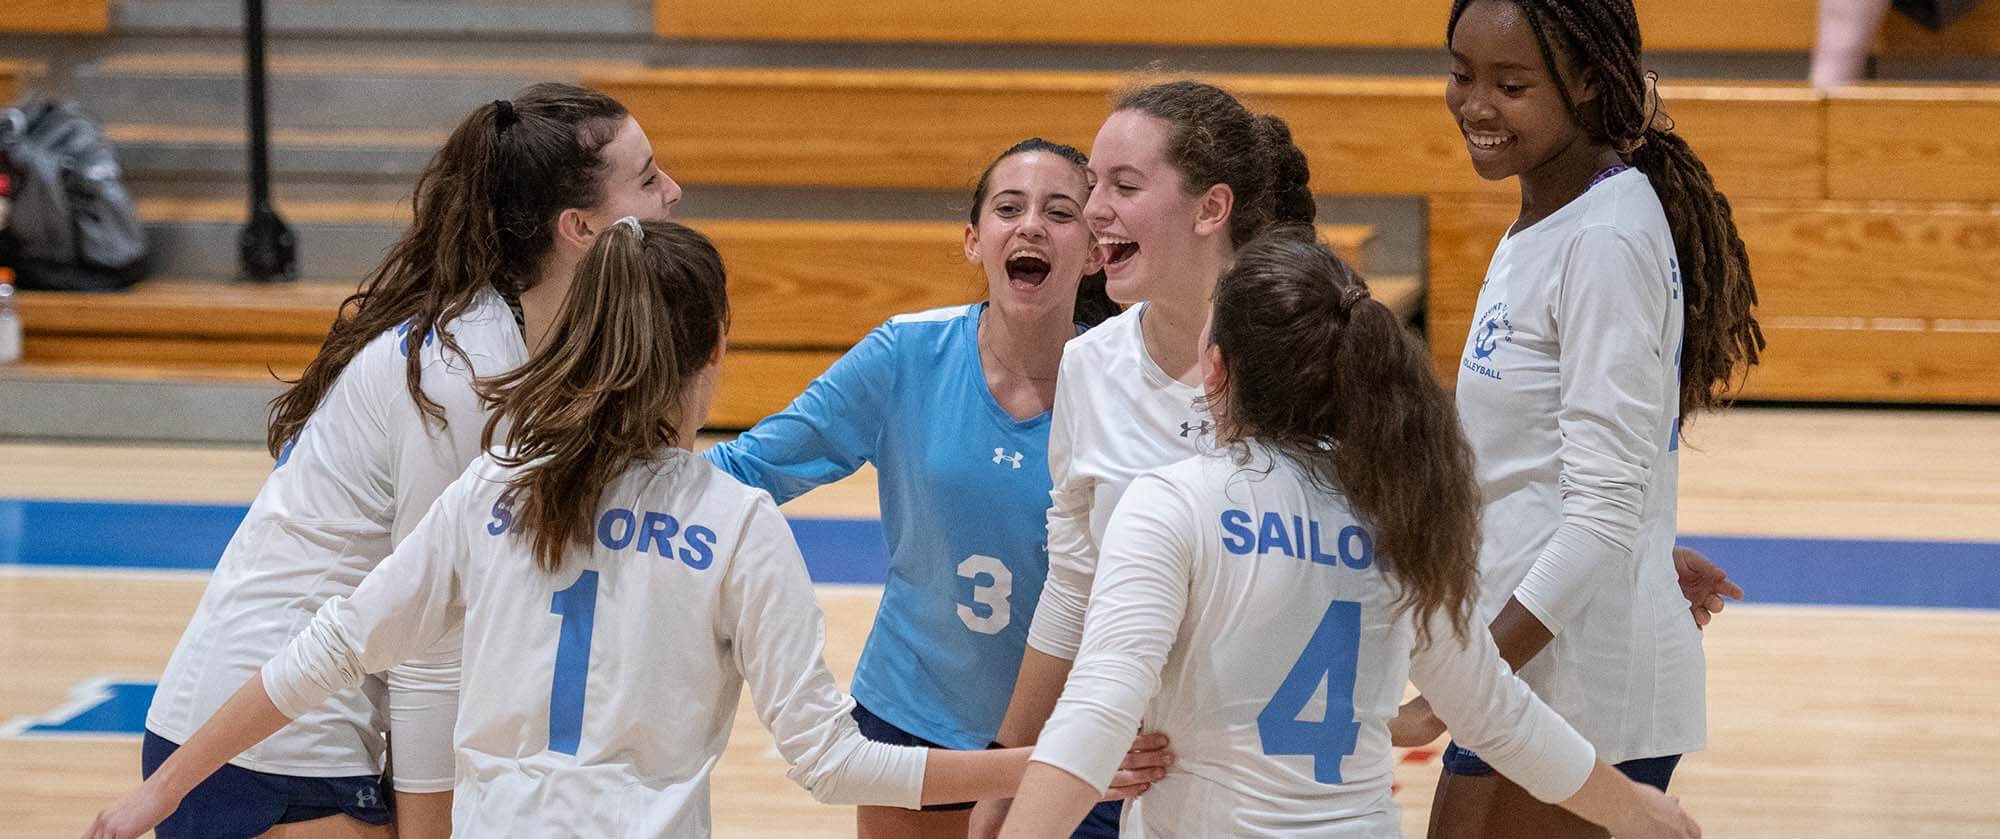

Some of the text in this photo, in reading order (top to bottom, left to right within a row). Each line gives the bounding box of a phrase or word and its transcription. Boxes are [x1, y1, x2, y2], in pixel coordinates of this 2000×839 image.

[1463, 357, 1503, 380] OLLEYBALL
[486, 494, 718, 571] SORS
[1220, 508, 1375, 570] SAILO
[956, 554, 1013, 635] 3
[548, 569, 599, 757] 1
[1257, 600, 1362, 784] 4
